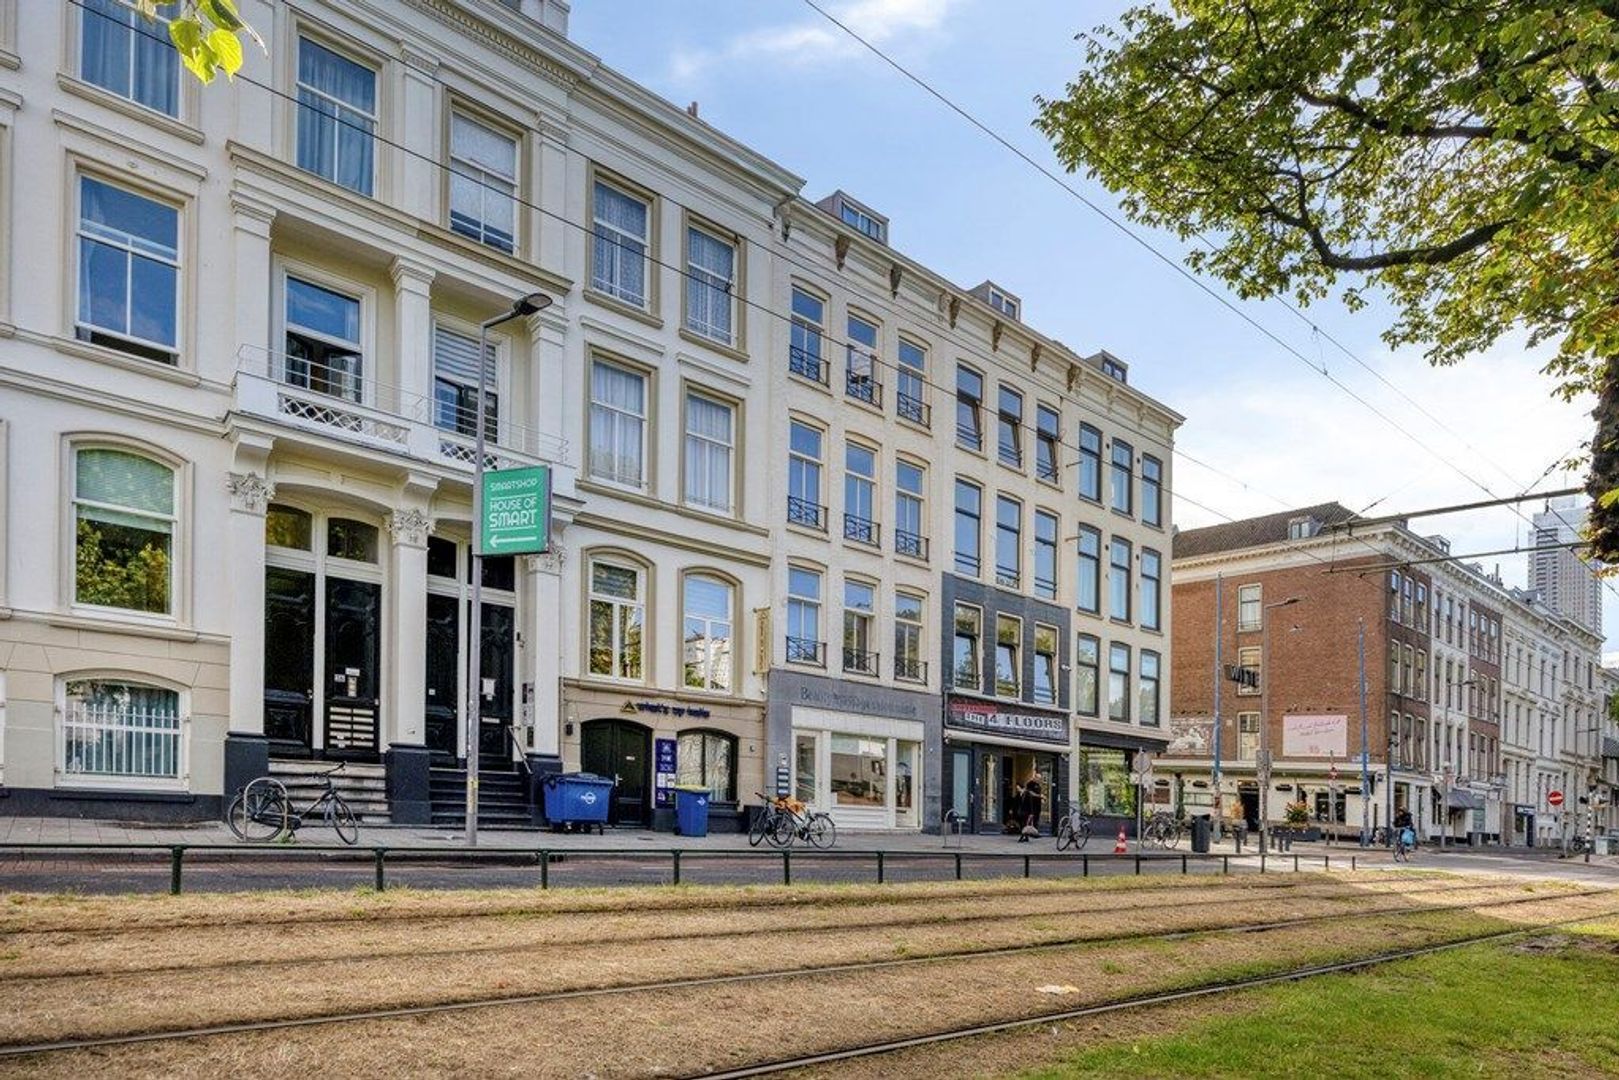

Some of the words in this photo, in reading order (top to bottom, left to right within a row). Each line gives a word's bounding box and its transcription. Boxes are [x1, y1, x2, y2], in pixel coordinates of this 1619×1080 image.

[490, 498, 522, 511] HOUSE
[523, 496, 537, 509] OF
[489, 509, 537, 528] SMART
[1005, 714, 1063, 731] FLOORS
